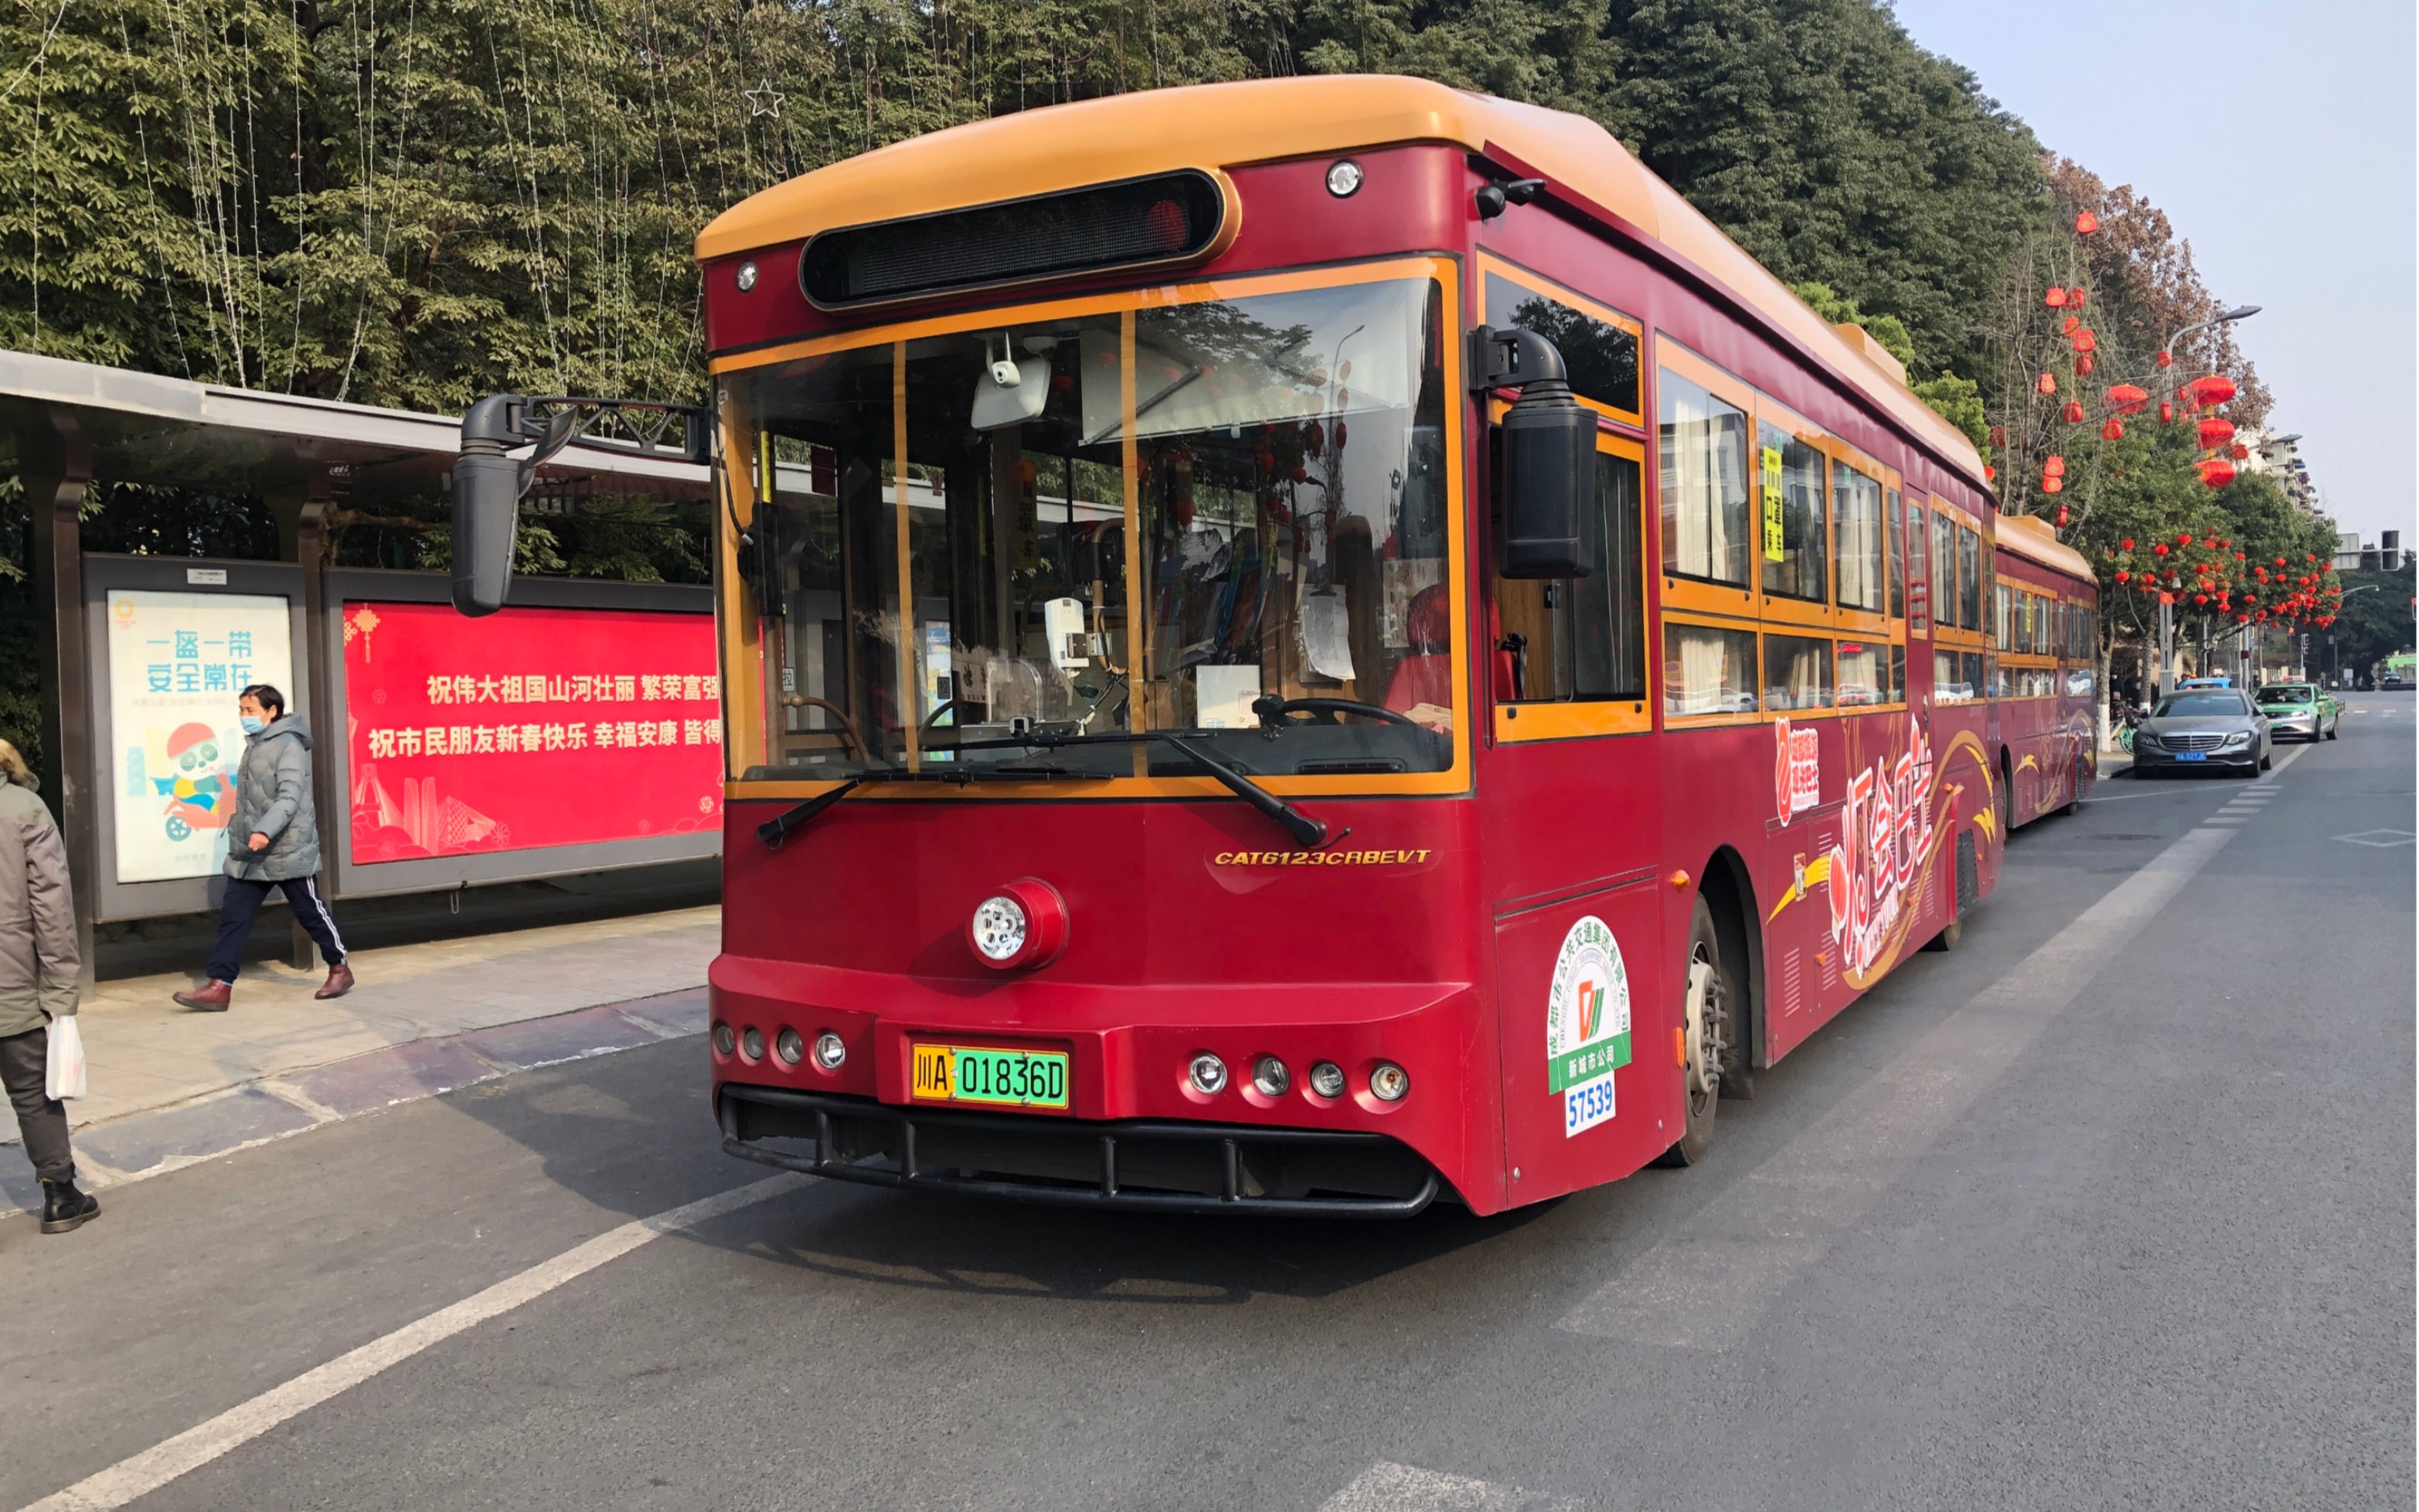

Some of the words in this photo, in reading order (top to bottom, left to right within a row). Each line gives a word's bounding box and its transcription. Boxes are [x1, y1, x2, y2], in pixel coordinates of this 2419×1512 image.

[146, 630, 251, 658] 一盔一带
[148, 663, 253, 692] 安全常在
[427, 674, 635, 705] 祝伟大祖国山河壮丽
[641, 674, 719, 702] 繁荣富强
[368, 722, 588, 759] 祝市民朋友新春快乐
[594, 719, 679, 749] 幸福安康
[684, 719, 721, 746] 皆得
[1214, 850, 1432, 865] CAT6123CRBEVT
[1549, 922, 1629, 1055] 成都市公共交通集团有限公司
[1569, 1045, 1614, 1079] 新城市公司
[1569, 1079, 1613, 1127] 57539
